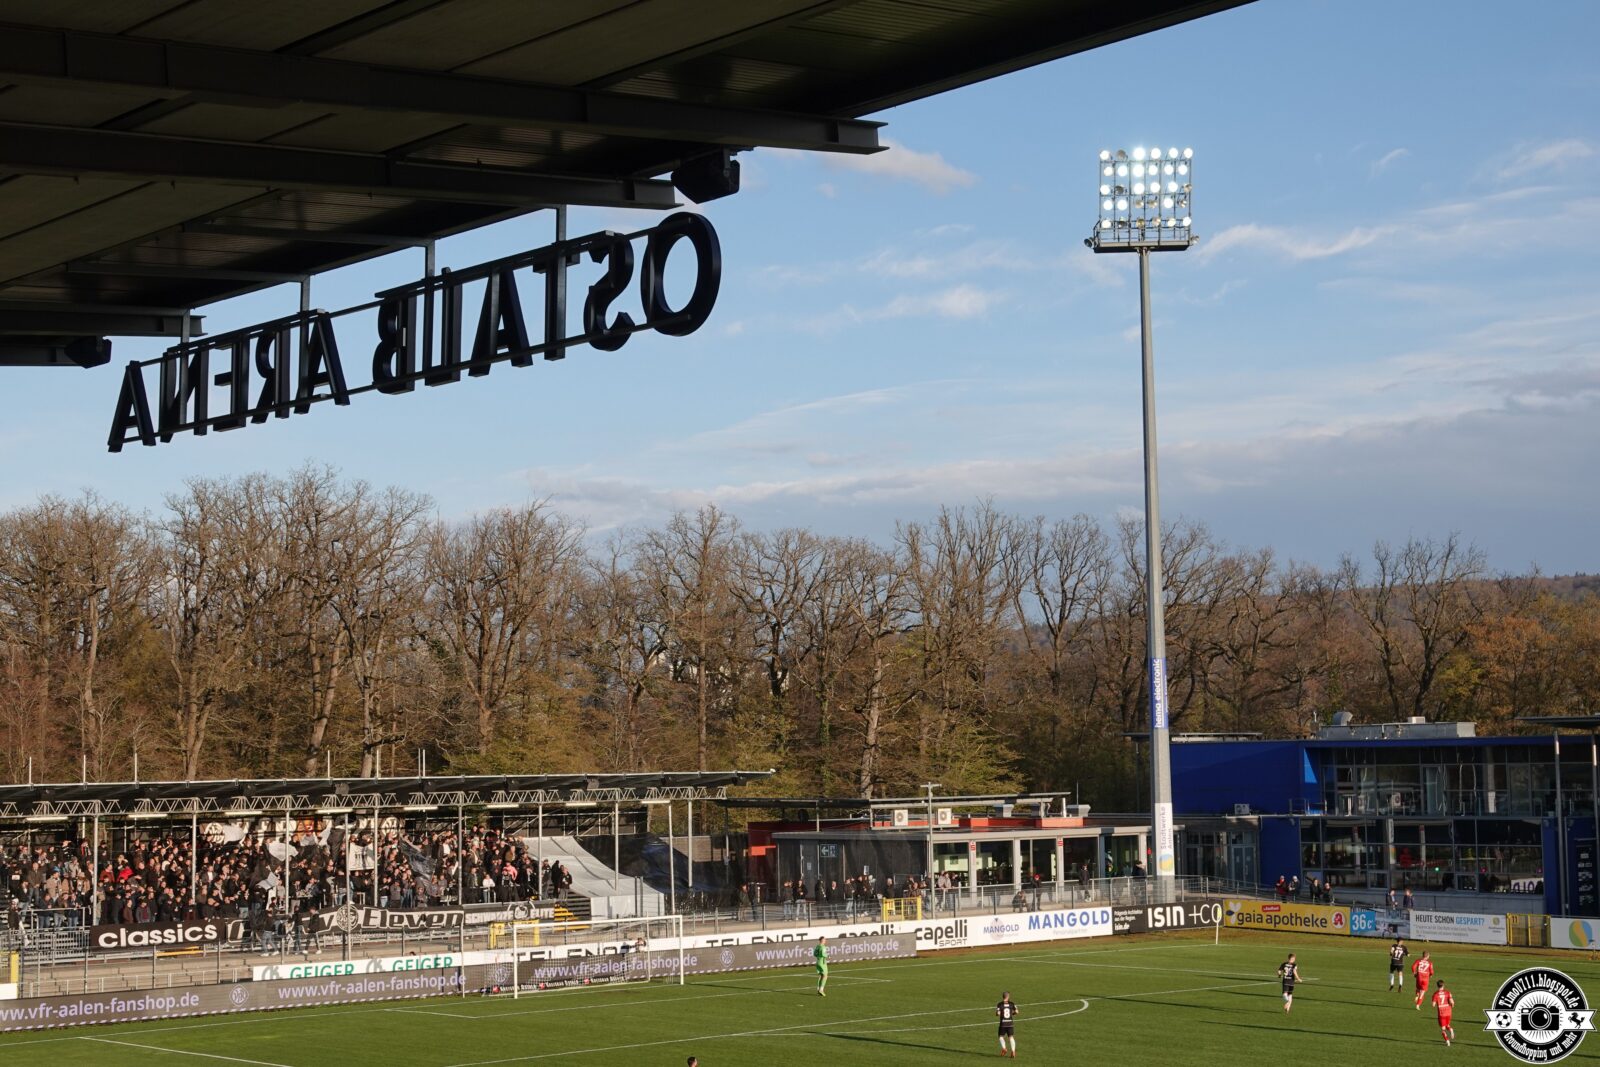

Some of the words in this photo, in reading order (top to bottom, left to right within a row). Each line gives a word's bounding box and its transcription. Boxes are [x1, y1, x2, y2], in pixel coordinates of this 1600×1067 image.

[1152, 658, 1161, 701] electronic
[361, 907, 464, 929] Eleven
[1028, 910, 1110, 930] MANGOLD
[1237, 909, 1263, 926] gaia
[1265, 912, 1328, 928] apotheke
[1415, 914, 1433, 923] HEUTE
[1434, 915, 1455, 924] SCHON
[1455, 916, 1485, 926] GESPART?
[98, 923, 218, 947] classics
[914, 919, 968, 945] capelli
[983, 924, 1020, 934] MANGOLD
[756, 940, 899, 961] www.vfr-aen-fanshop.de
[938, 938, 968, 947] SPORT
[290, 963, 355, 979] GEIGER
[392, 956, 453, 972] GEIGER
[1439, 995, 1445, 1004] 7
[1004, 1008, 1010, 1018] 8
